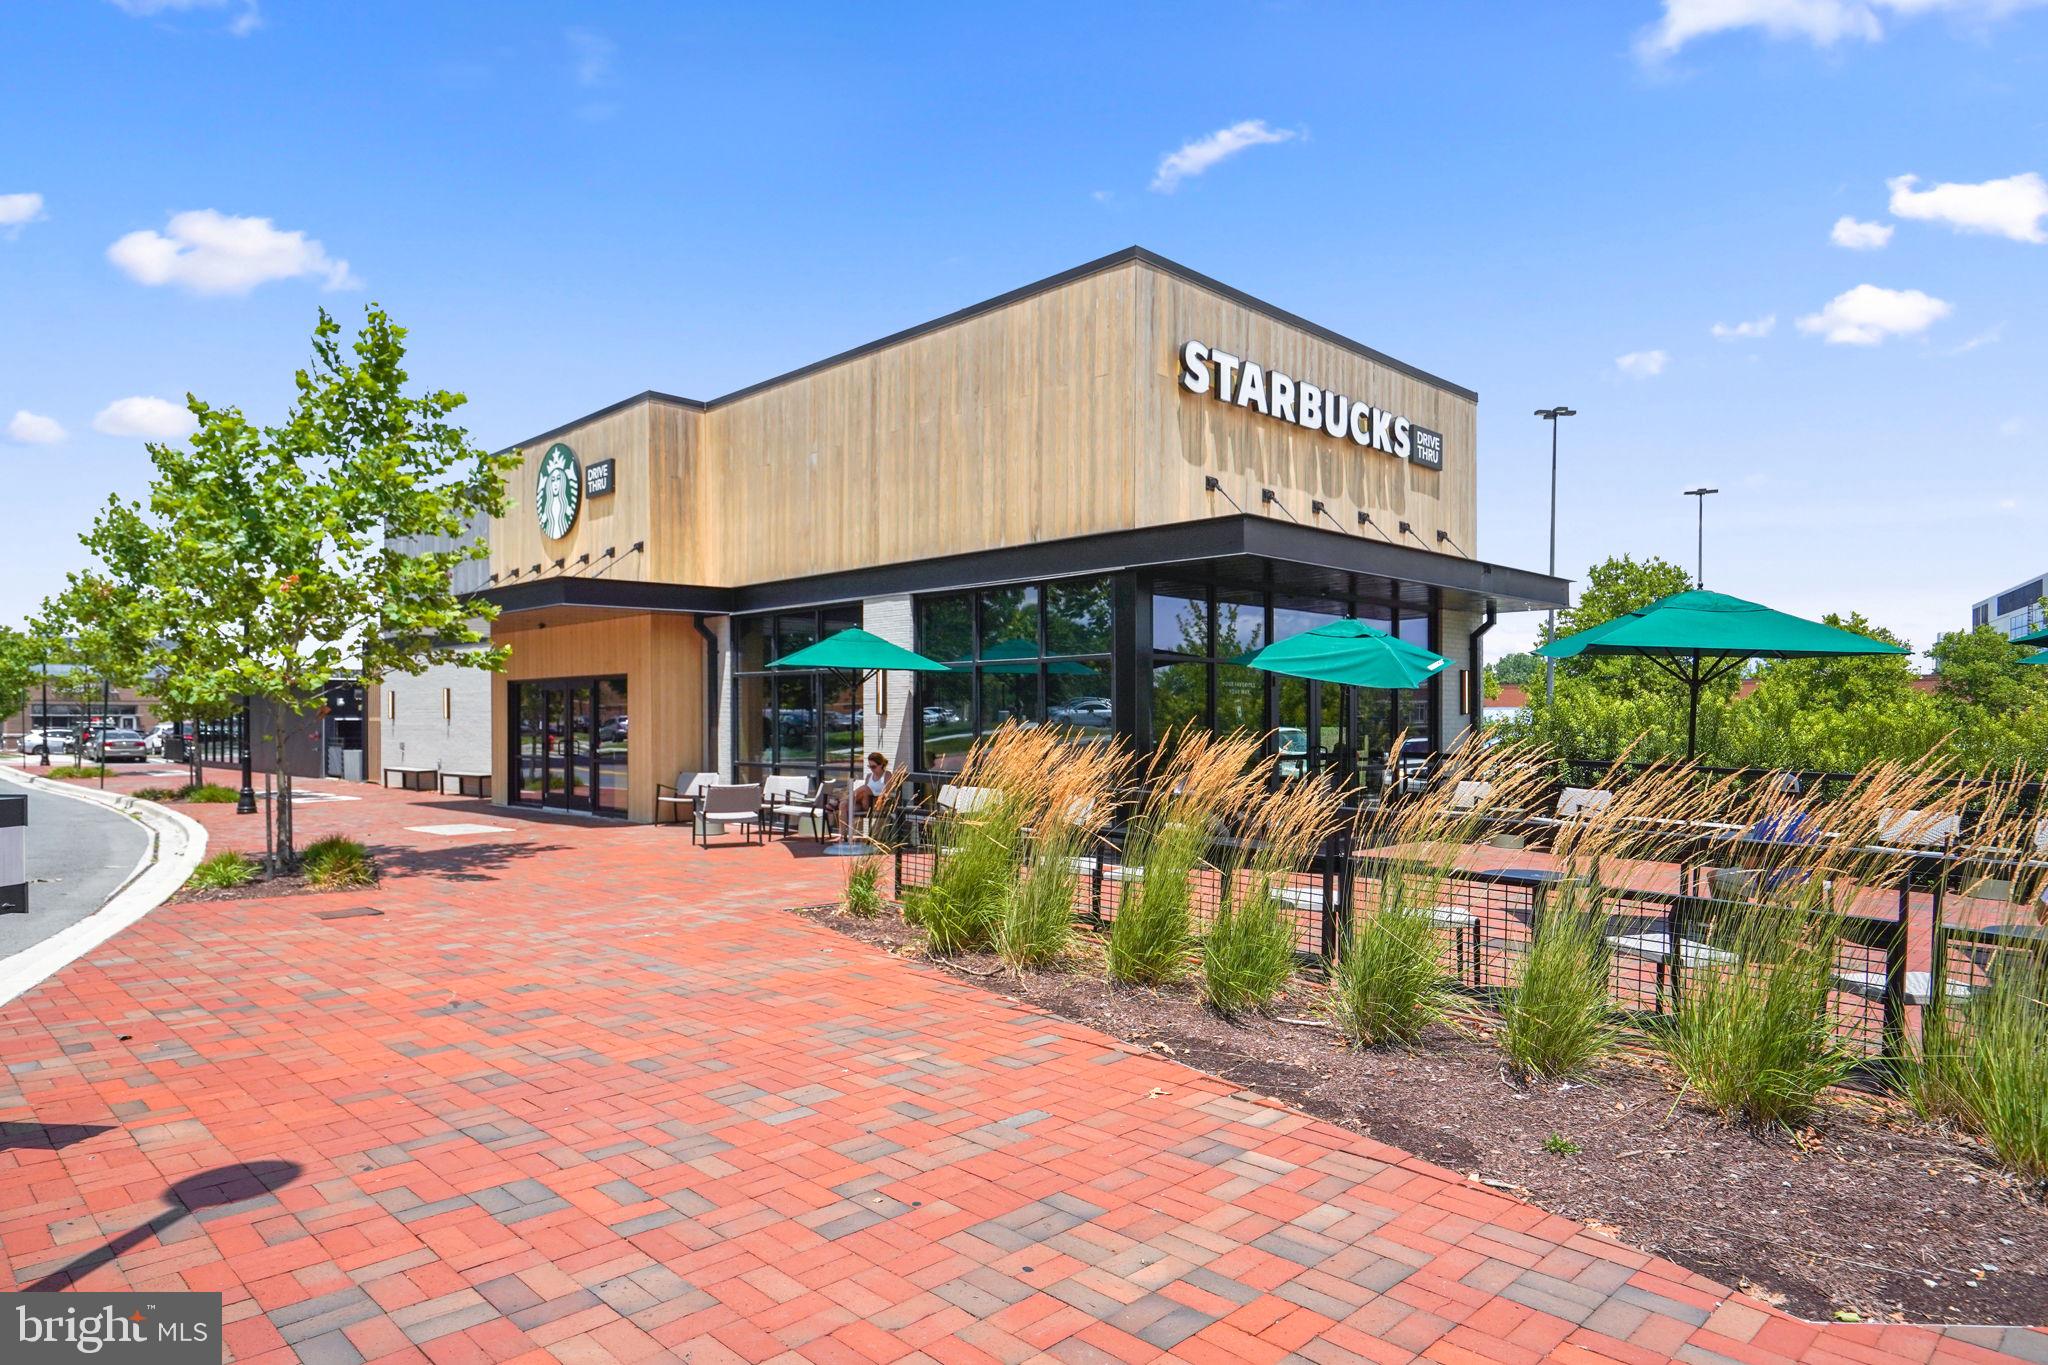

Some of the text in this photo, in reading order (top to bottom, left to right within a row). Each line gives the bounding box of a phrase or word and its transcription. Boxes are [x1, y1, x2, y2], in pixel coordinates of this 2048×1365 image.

[1180, 340, 1411, 458] STARBUCKS
[1416, 430, 1440, 451] DRIVE
[1416, 445, 1439, 464] THRU
[587, 464, 608, 480] DRIVE
[587, 478, 607, 493] THRU
